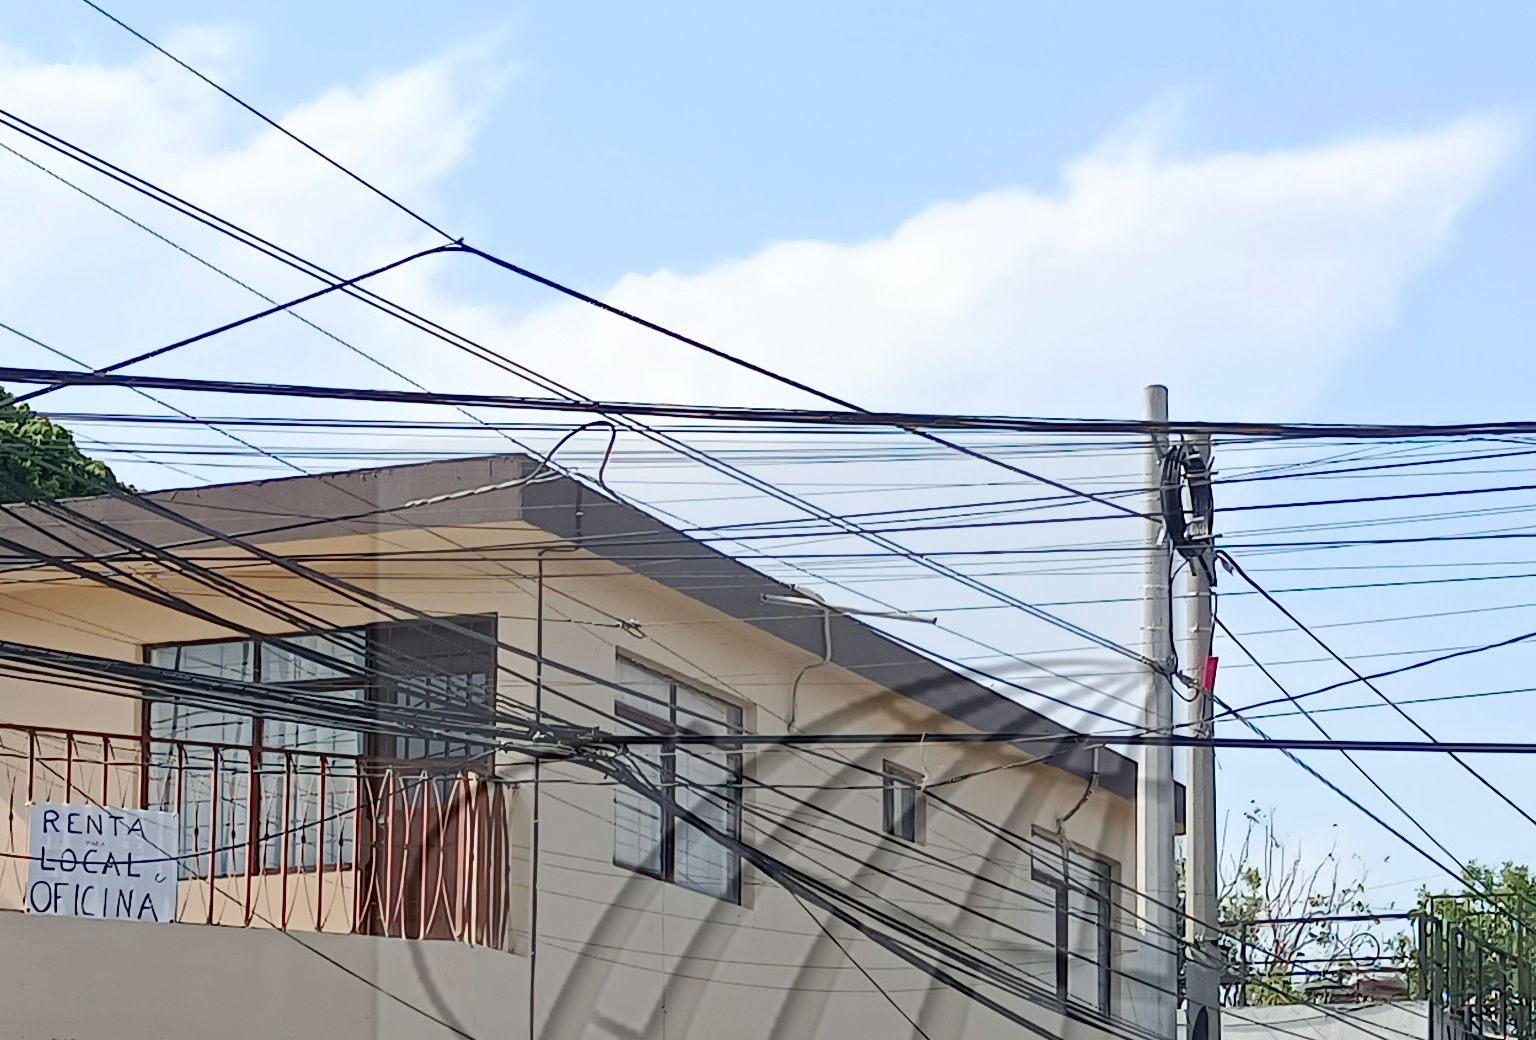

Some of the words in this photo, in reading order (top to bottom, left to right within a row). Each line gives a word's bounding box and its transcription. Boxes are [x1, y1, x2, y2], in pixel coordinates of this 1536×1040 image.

[43, 809, 145, 838] RENTA
[40, 846, 141, 878] LOCAL
[30, 880, 159, 922] OFICINA
